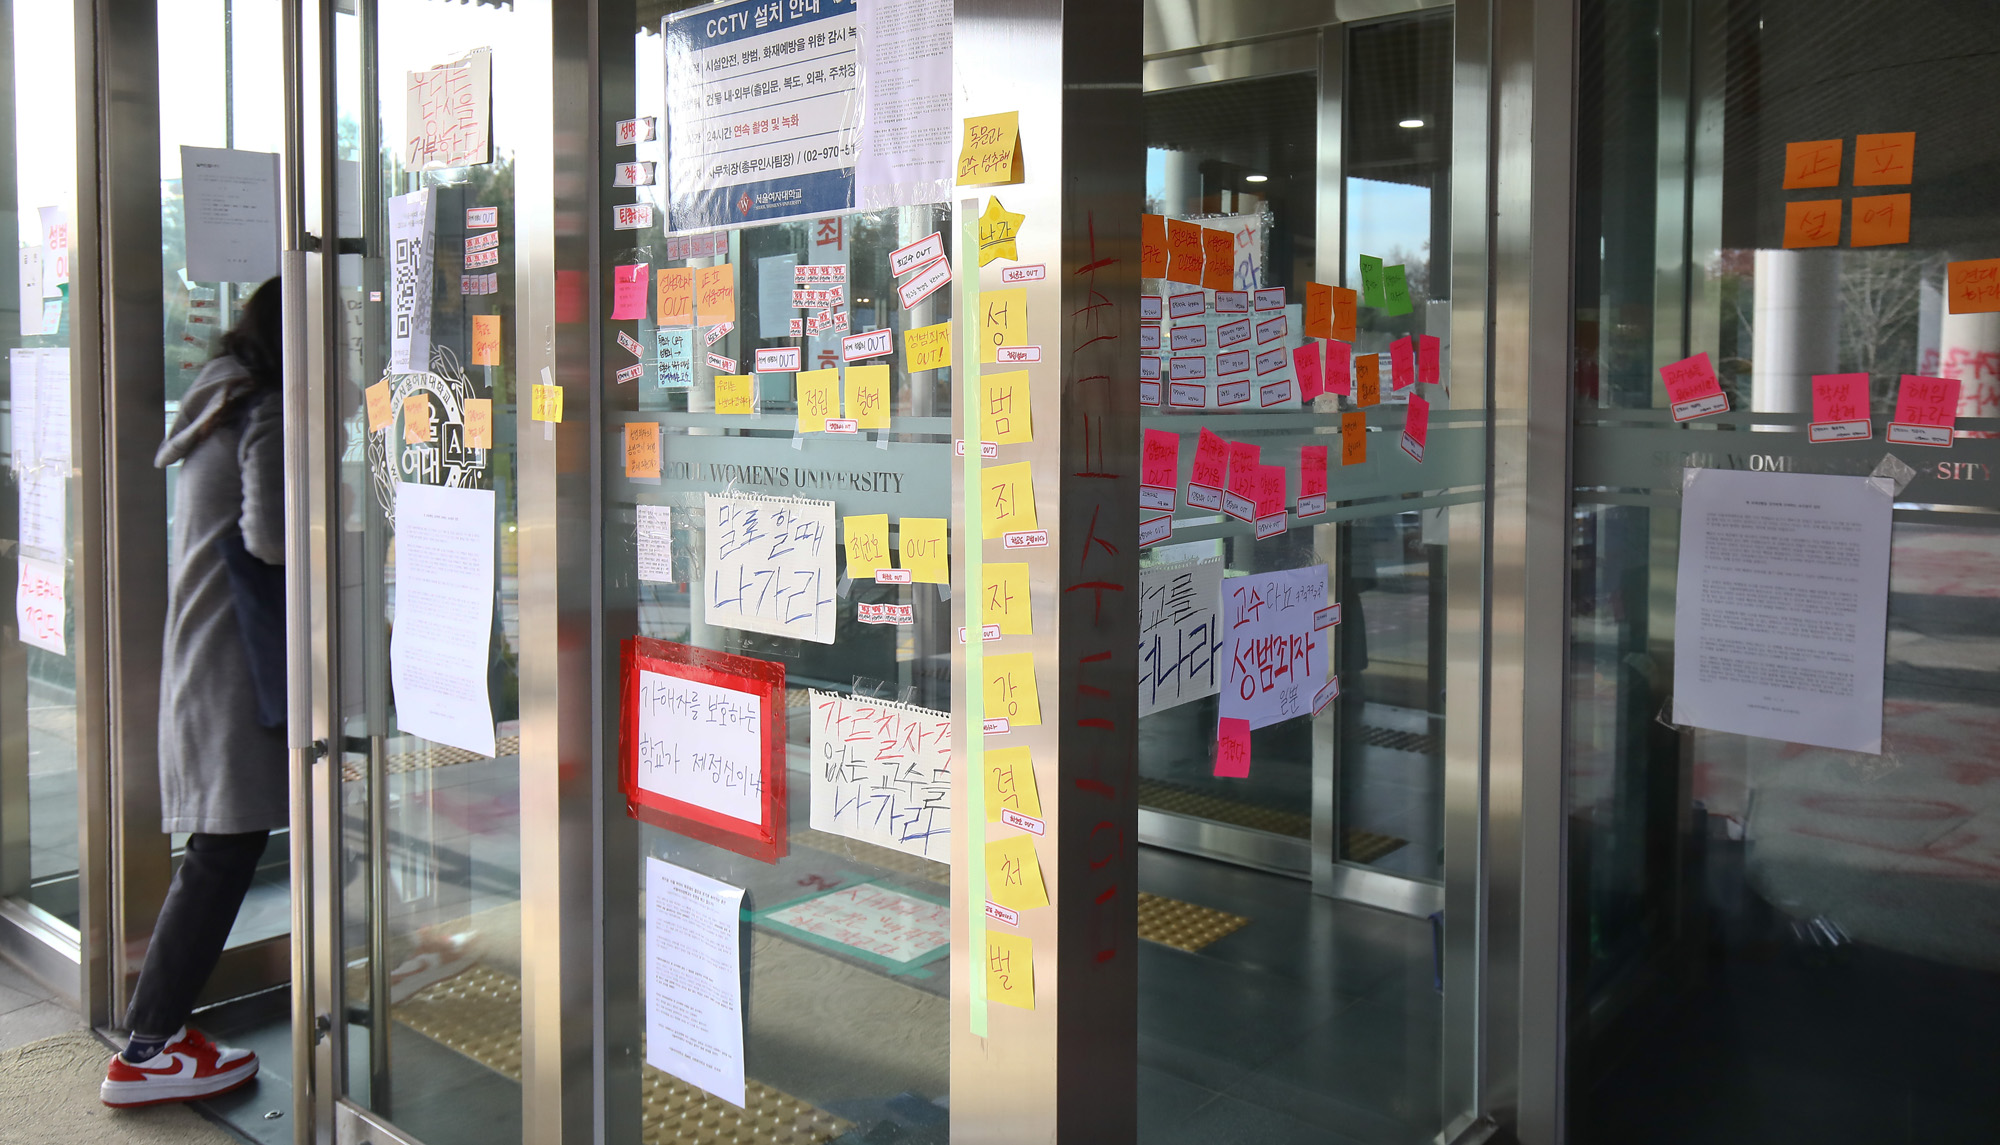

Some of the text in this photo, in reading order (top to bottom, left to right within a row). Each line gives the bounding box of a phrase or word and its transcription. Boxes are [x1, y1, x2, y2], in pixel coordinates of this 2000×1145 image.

[706, 0, 820, 38] CCTV 설치 안내
[705, 55, 740, 73] 시설안전,
[763, 38, 805, 59] 화재예방을
[808, 33, 826, 49] 위한
[828, 28, 846, 44] 감시
[706, 114, 799, 142] 24시간 연속 촬영 및 녹화
[970, 125, 1004, 149] 독문과
[960, 150, 1011, 177] 교수 성추행
[755, 189, 802, 204] 서울여자대학교
[980, 221, 1011, 241] 나가
[915, 246, 932, 259] OUT
[664, 297, 689, 317] OUT
[868, 336, 886, 351] OUT
[908, 329, 951, 348] 성범죄자
[779, 354, 796, 368] OUT
[917, 347, 944, 365] OUT!
[805, 387, 828, 416] 정립
[857, 386, 880, 416] 설여
[1907, 383, 1948, 404] 해임
[1906, 405, 1951, 425] 하라
[710, 464, 789, 487] WOMEN'S
[795, 468, 904, 493] UNIVERSITY
[1149, 469, 1173, 485] OUT
[718, 503, 768, 560] 말로
[907, 538, 941, 559] OUT
[713, 564, 832, 640] 나가라
[1230, 631, 1316, 701] 성범죄자
[641, 680, 757, 734] 가해자를 보호하는
[818, 701, 904, 761] 가르칠
[639, 732, 766, 798] 학교가 제정신이냐
[823, 741, 869, 784] 없는
[833, 783, 950, 856] 나가라
